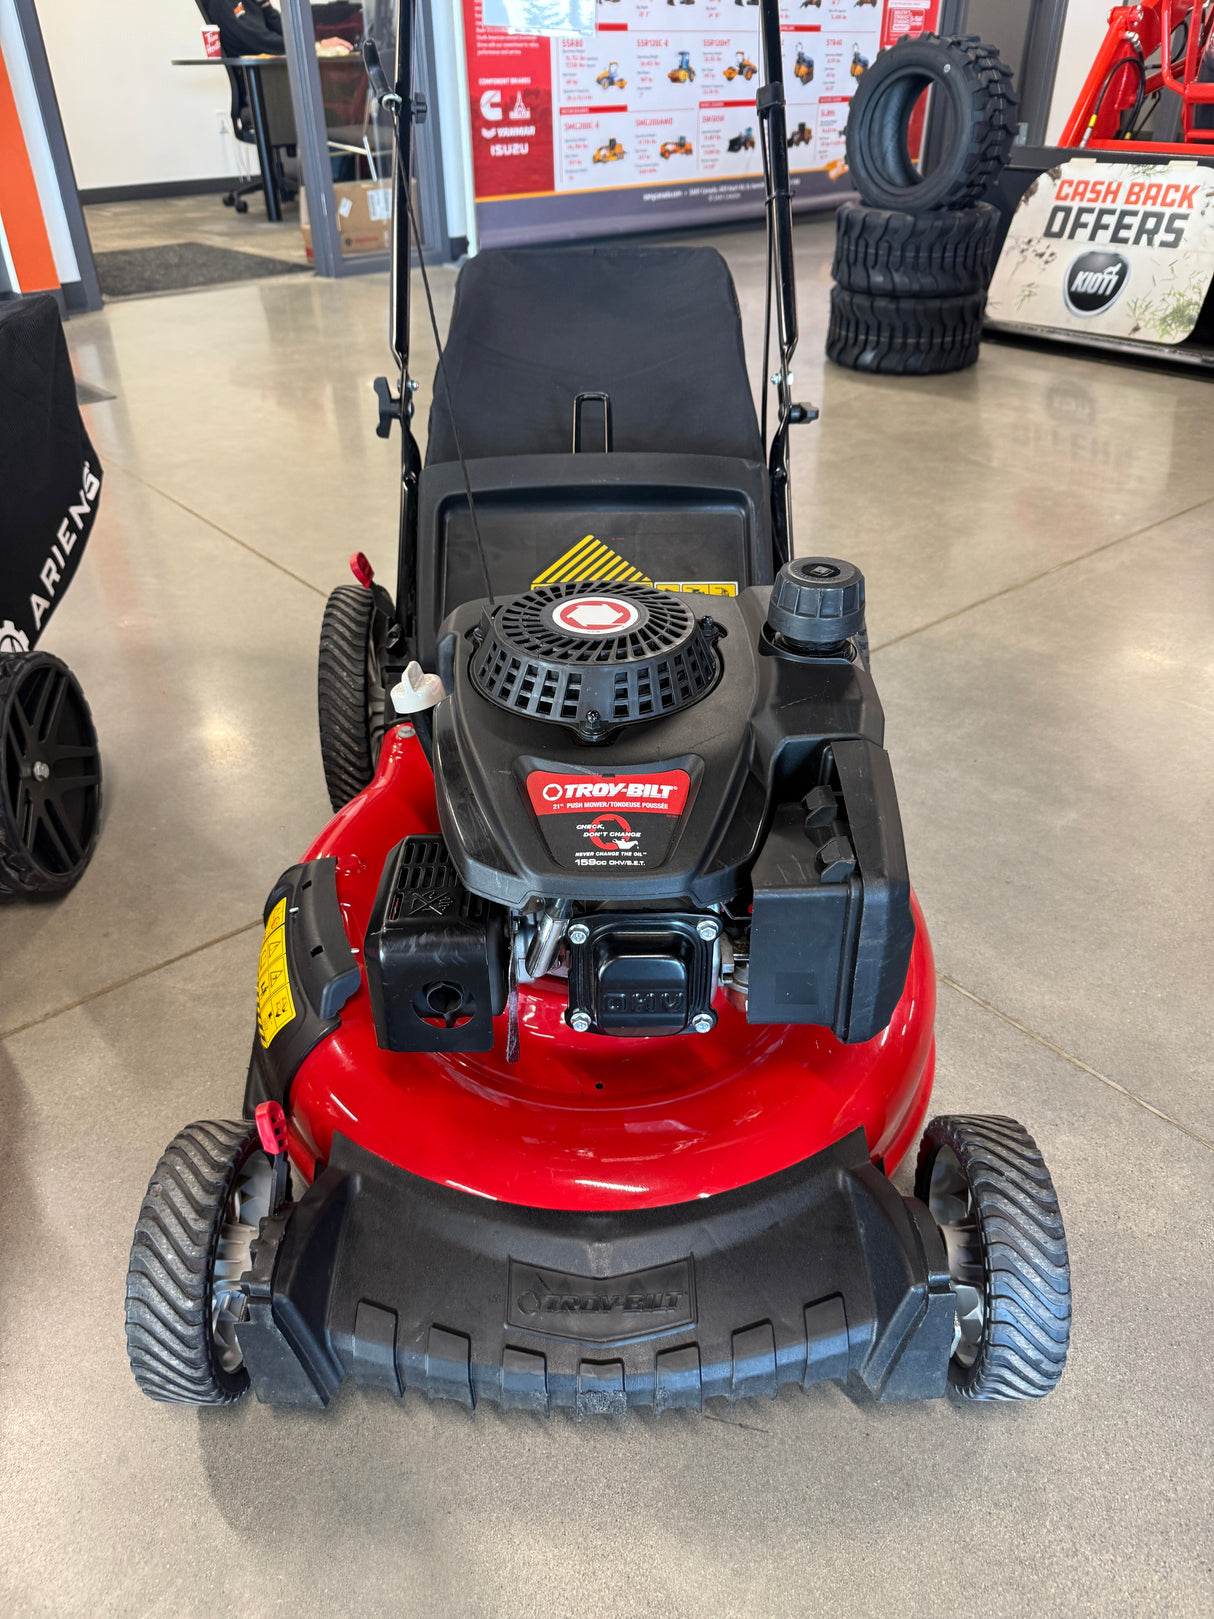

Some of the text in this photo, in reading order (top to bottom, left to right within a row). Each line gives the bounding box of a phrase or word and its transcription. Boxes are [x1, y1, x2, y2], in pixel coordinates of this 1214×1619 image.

[497, 125, 536, 138] YANMAR
[490, 142, 529, 157] ISUZU
[1055, 179, 1201, 209] CASH BACK
[1043, 204, 1191, 249] OFFERS
[1070, 269, 1120, 296] KIOTI
[30, 463, 101, 632] ARIENS
[641, 801, 669, 810] POUSSÉE
[575, 858, 607, 866] 159cc
[603, 993, 684, 1013] OHV
[543, 1292, 684, 1313] TROY-BILT
